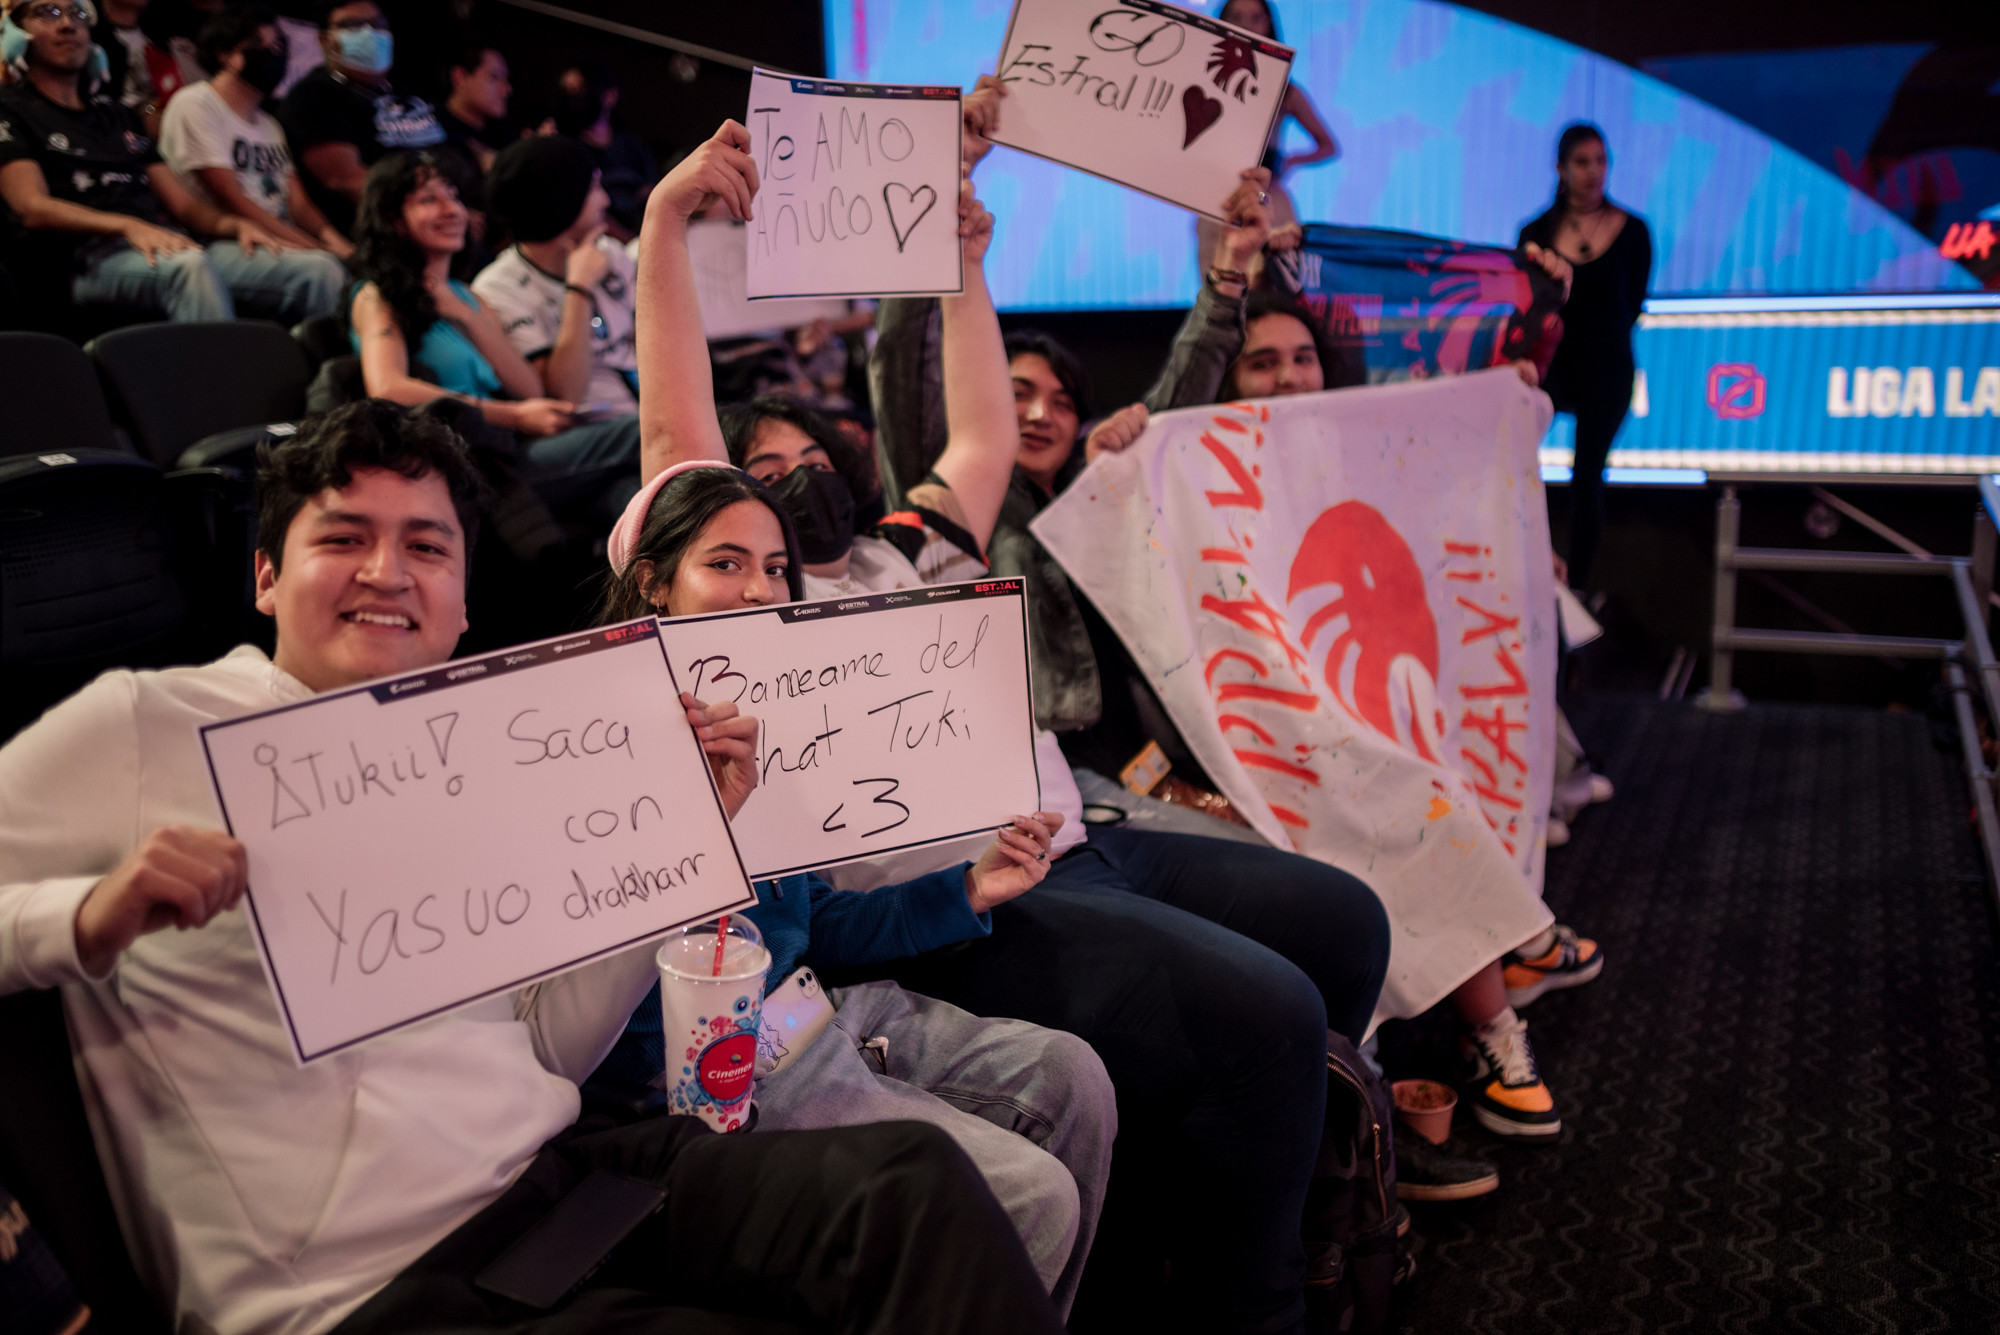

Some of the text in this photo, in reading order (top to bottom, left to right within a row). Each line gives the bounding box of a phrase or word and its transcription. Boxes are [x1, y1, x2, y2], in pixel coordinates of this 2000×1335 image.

[811, 106, 915, 183] AMO
[1826, 366, 1936, 418] LIGA
[920, 614, 990, 674] del
[507, 709, 635, 766] Saca
[752, 690, 971, 787] hat Tuki
[565, 795, 664, 843] con
[822, 777, 911, 838] <3
